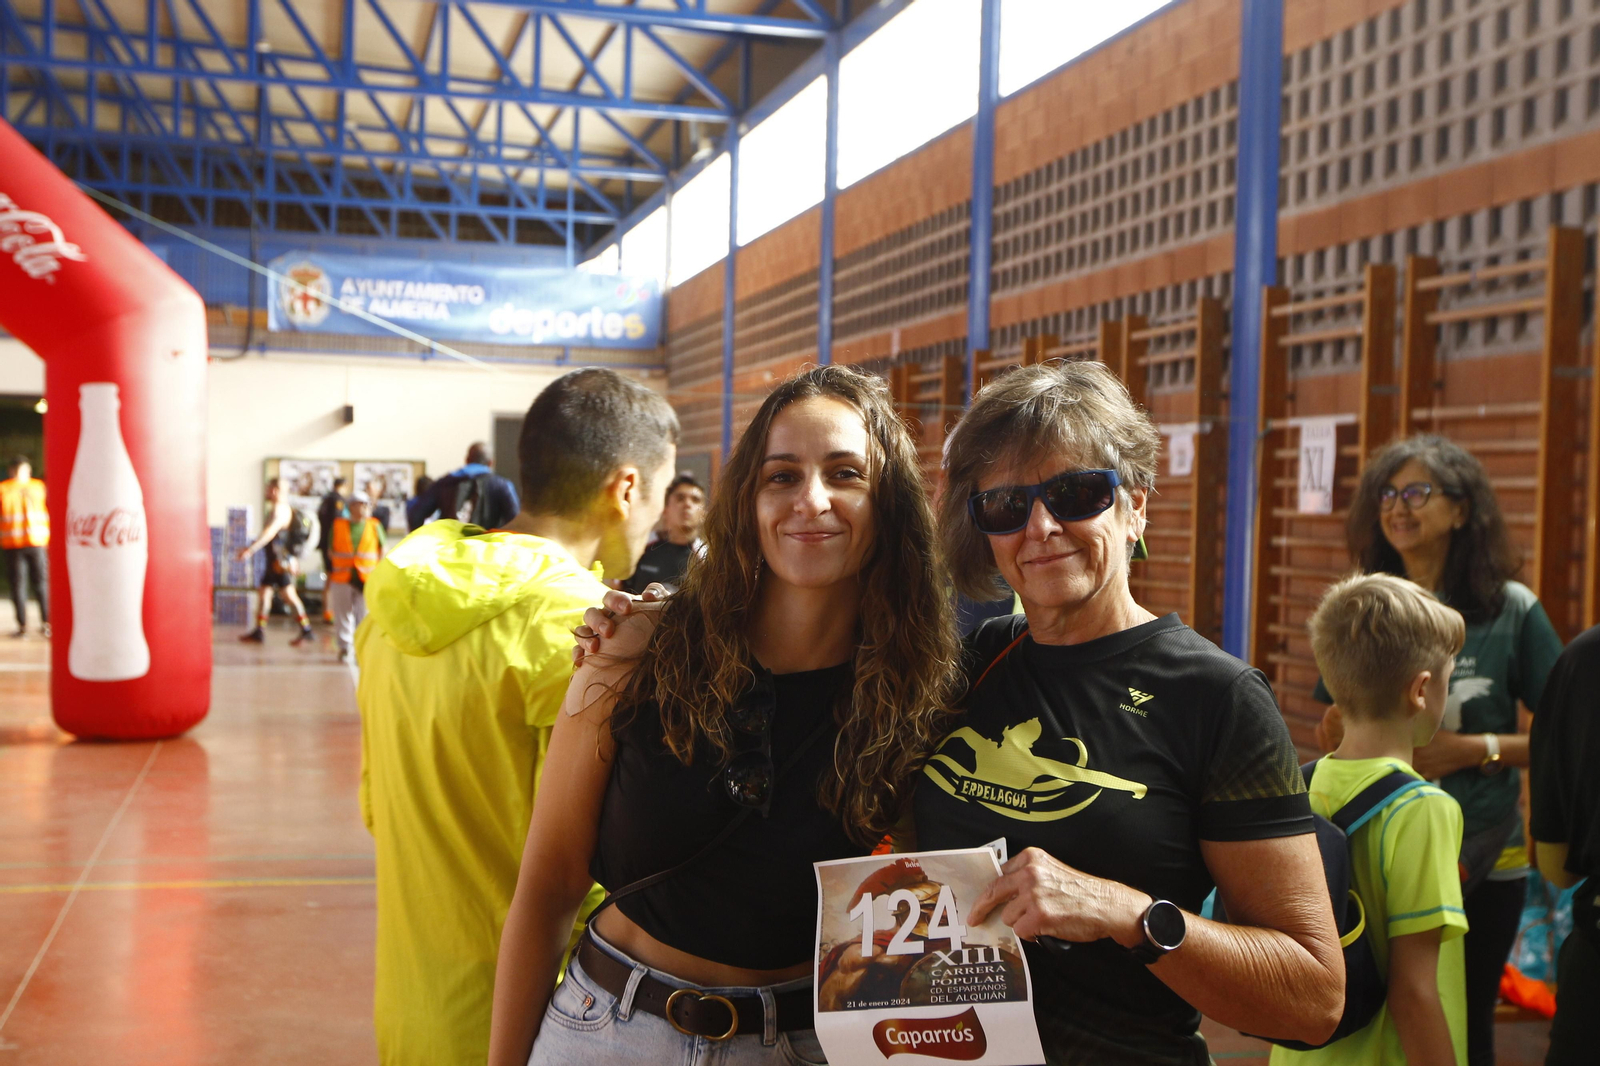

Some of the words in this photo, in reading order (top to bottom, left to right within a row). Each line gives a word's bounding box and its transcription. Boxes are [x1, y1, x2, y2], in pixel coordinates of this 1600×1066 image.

[341, 277, 485, 305] AYUNTAMIENTO
[489, 304, 645, 343] deportes
[1303, 446, 1327, 492] XL
[1119, 702, 1148, 718] HORME
[961, 780, 1028, 809] ERDELAGUA
[850, 885, 967, 957] 124
[931, 945, 1004, 968] XIII
[931, 965, 1006, 977] CARRERA
[931, 974, 1006, 986] POPULAR
[947, 983, 1007, 994] ESPARTANOS
[890, 998, 911, 1006] 2024
[930, 995, 952, 1003] DEL
